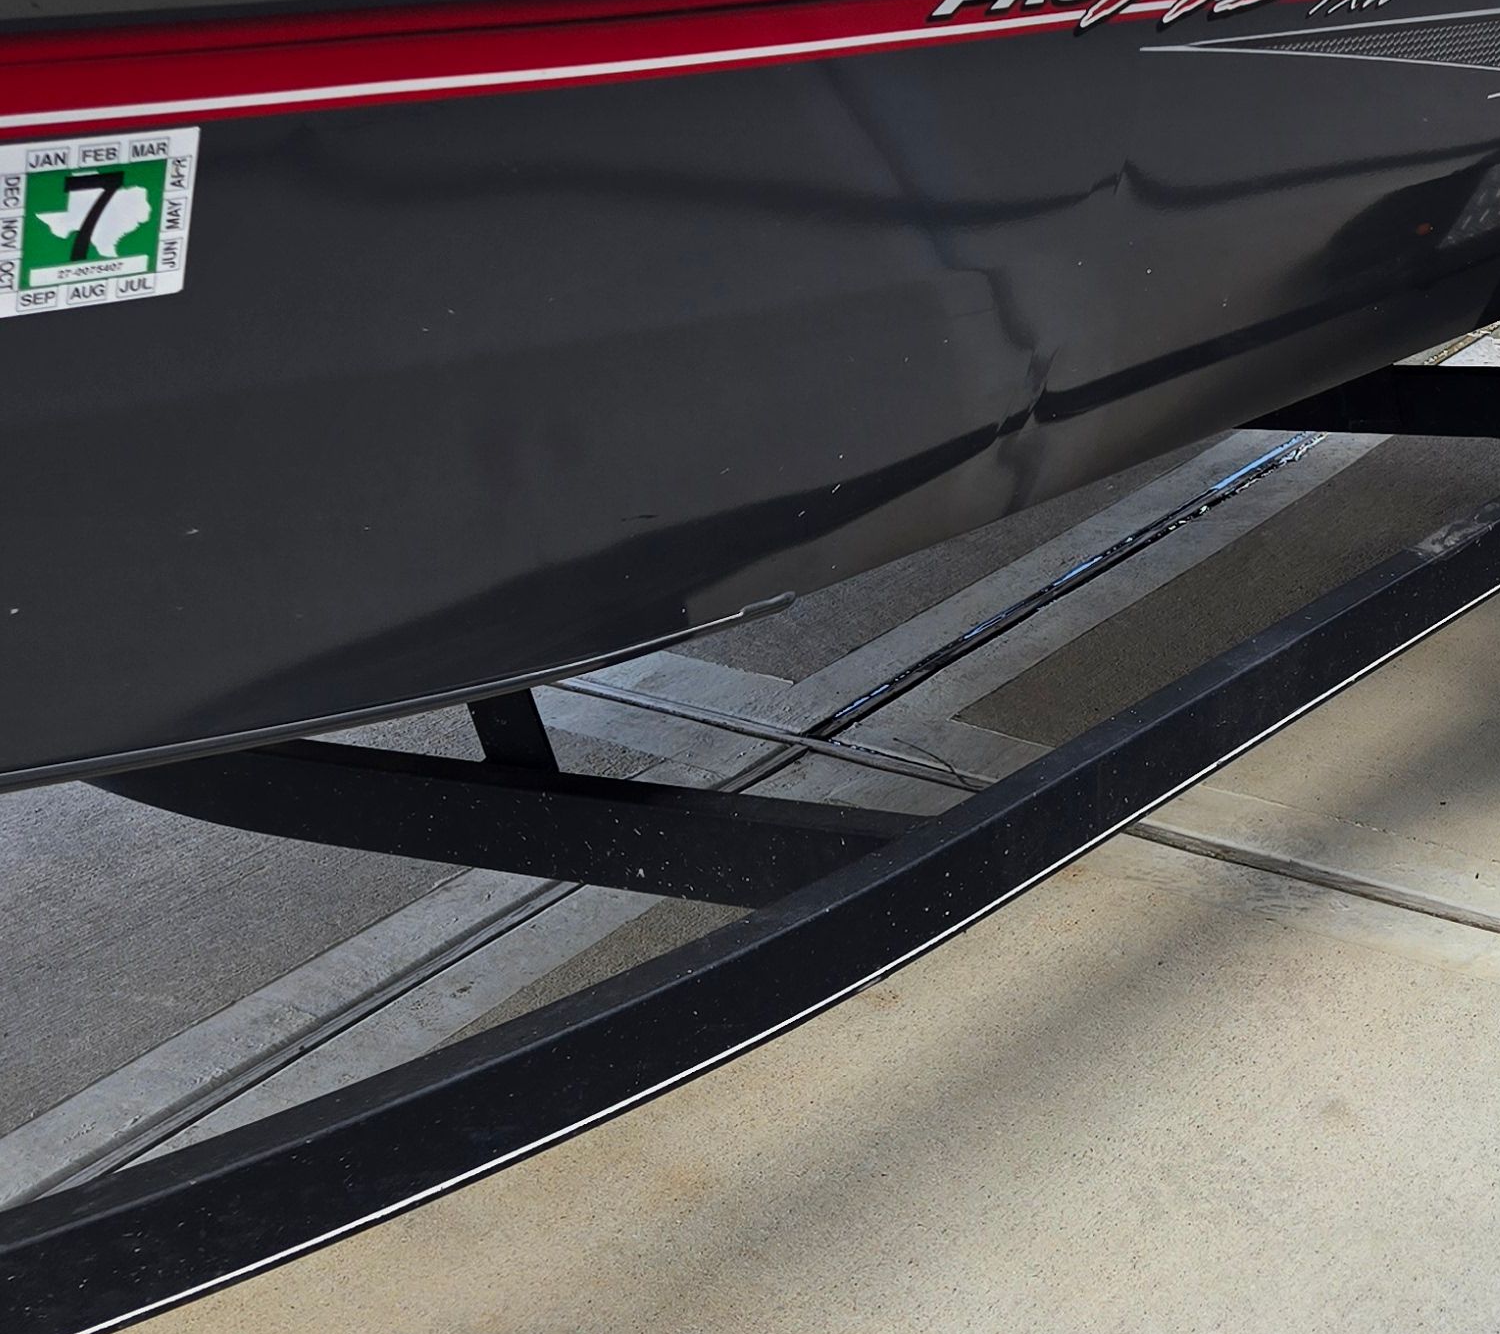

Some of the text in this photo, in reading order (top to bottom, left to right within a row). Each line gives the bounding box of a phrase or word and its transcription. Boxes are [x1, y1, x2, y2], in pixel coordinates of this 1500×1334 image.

[29, 151, 67, 168] JAN
[82, 147, 118, 163] FEB
[131, 142, 168, 158] MAR
[171, 157, 187, 189] APR
[3, 175, 21, 208] DEC
[64, 170, 125, 262] 7
[166, 200, 182, 229] MAY
[1, 218, 18, 249] NOV
[161, 240, 178, 268] JUN
[0, 261, 14, 291] OCT
[118, 277, 152, 293] JUL
[20, 291, 56, 307] SEP
[69, 284, 105, 300] AUG
